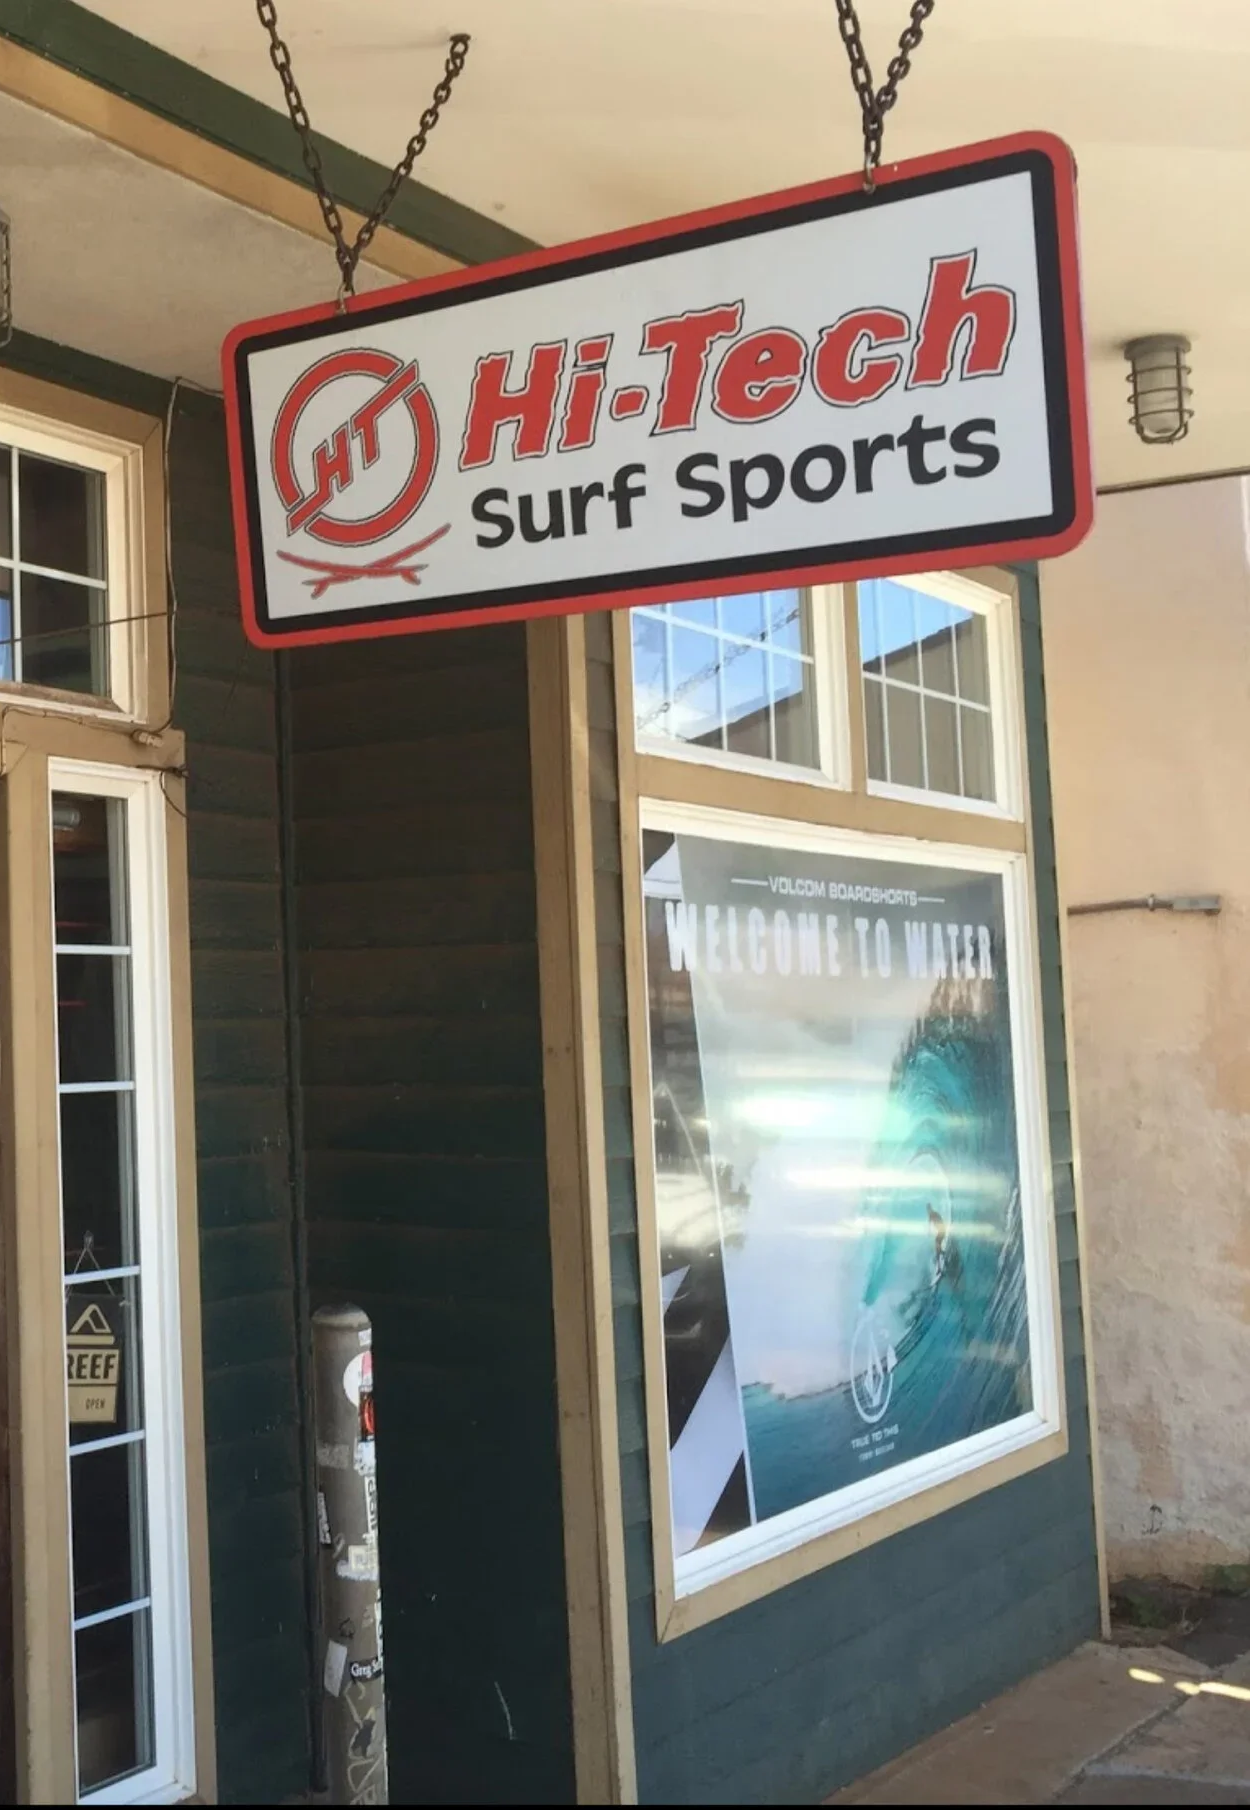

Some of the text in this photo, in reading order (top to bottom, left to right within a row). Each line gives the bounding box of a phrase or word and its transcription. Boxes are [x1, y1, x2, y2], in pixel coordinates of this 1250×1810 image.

[458, 249, 1016, 471] Hi-Tech
[471, 415, 1001, 548] Surf Sports
[768, 876, 918, 906] VOLCOM BOARDSHORTS
[665, 901, 993, 981] WELCOME TO WATER
[85, 1397, 106, 1410] OPEN
